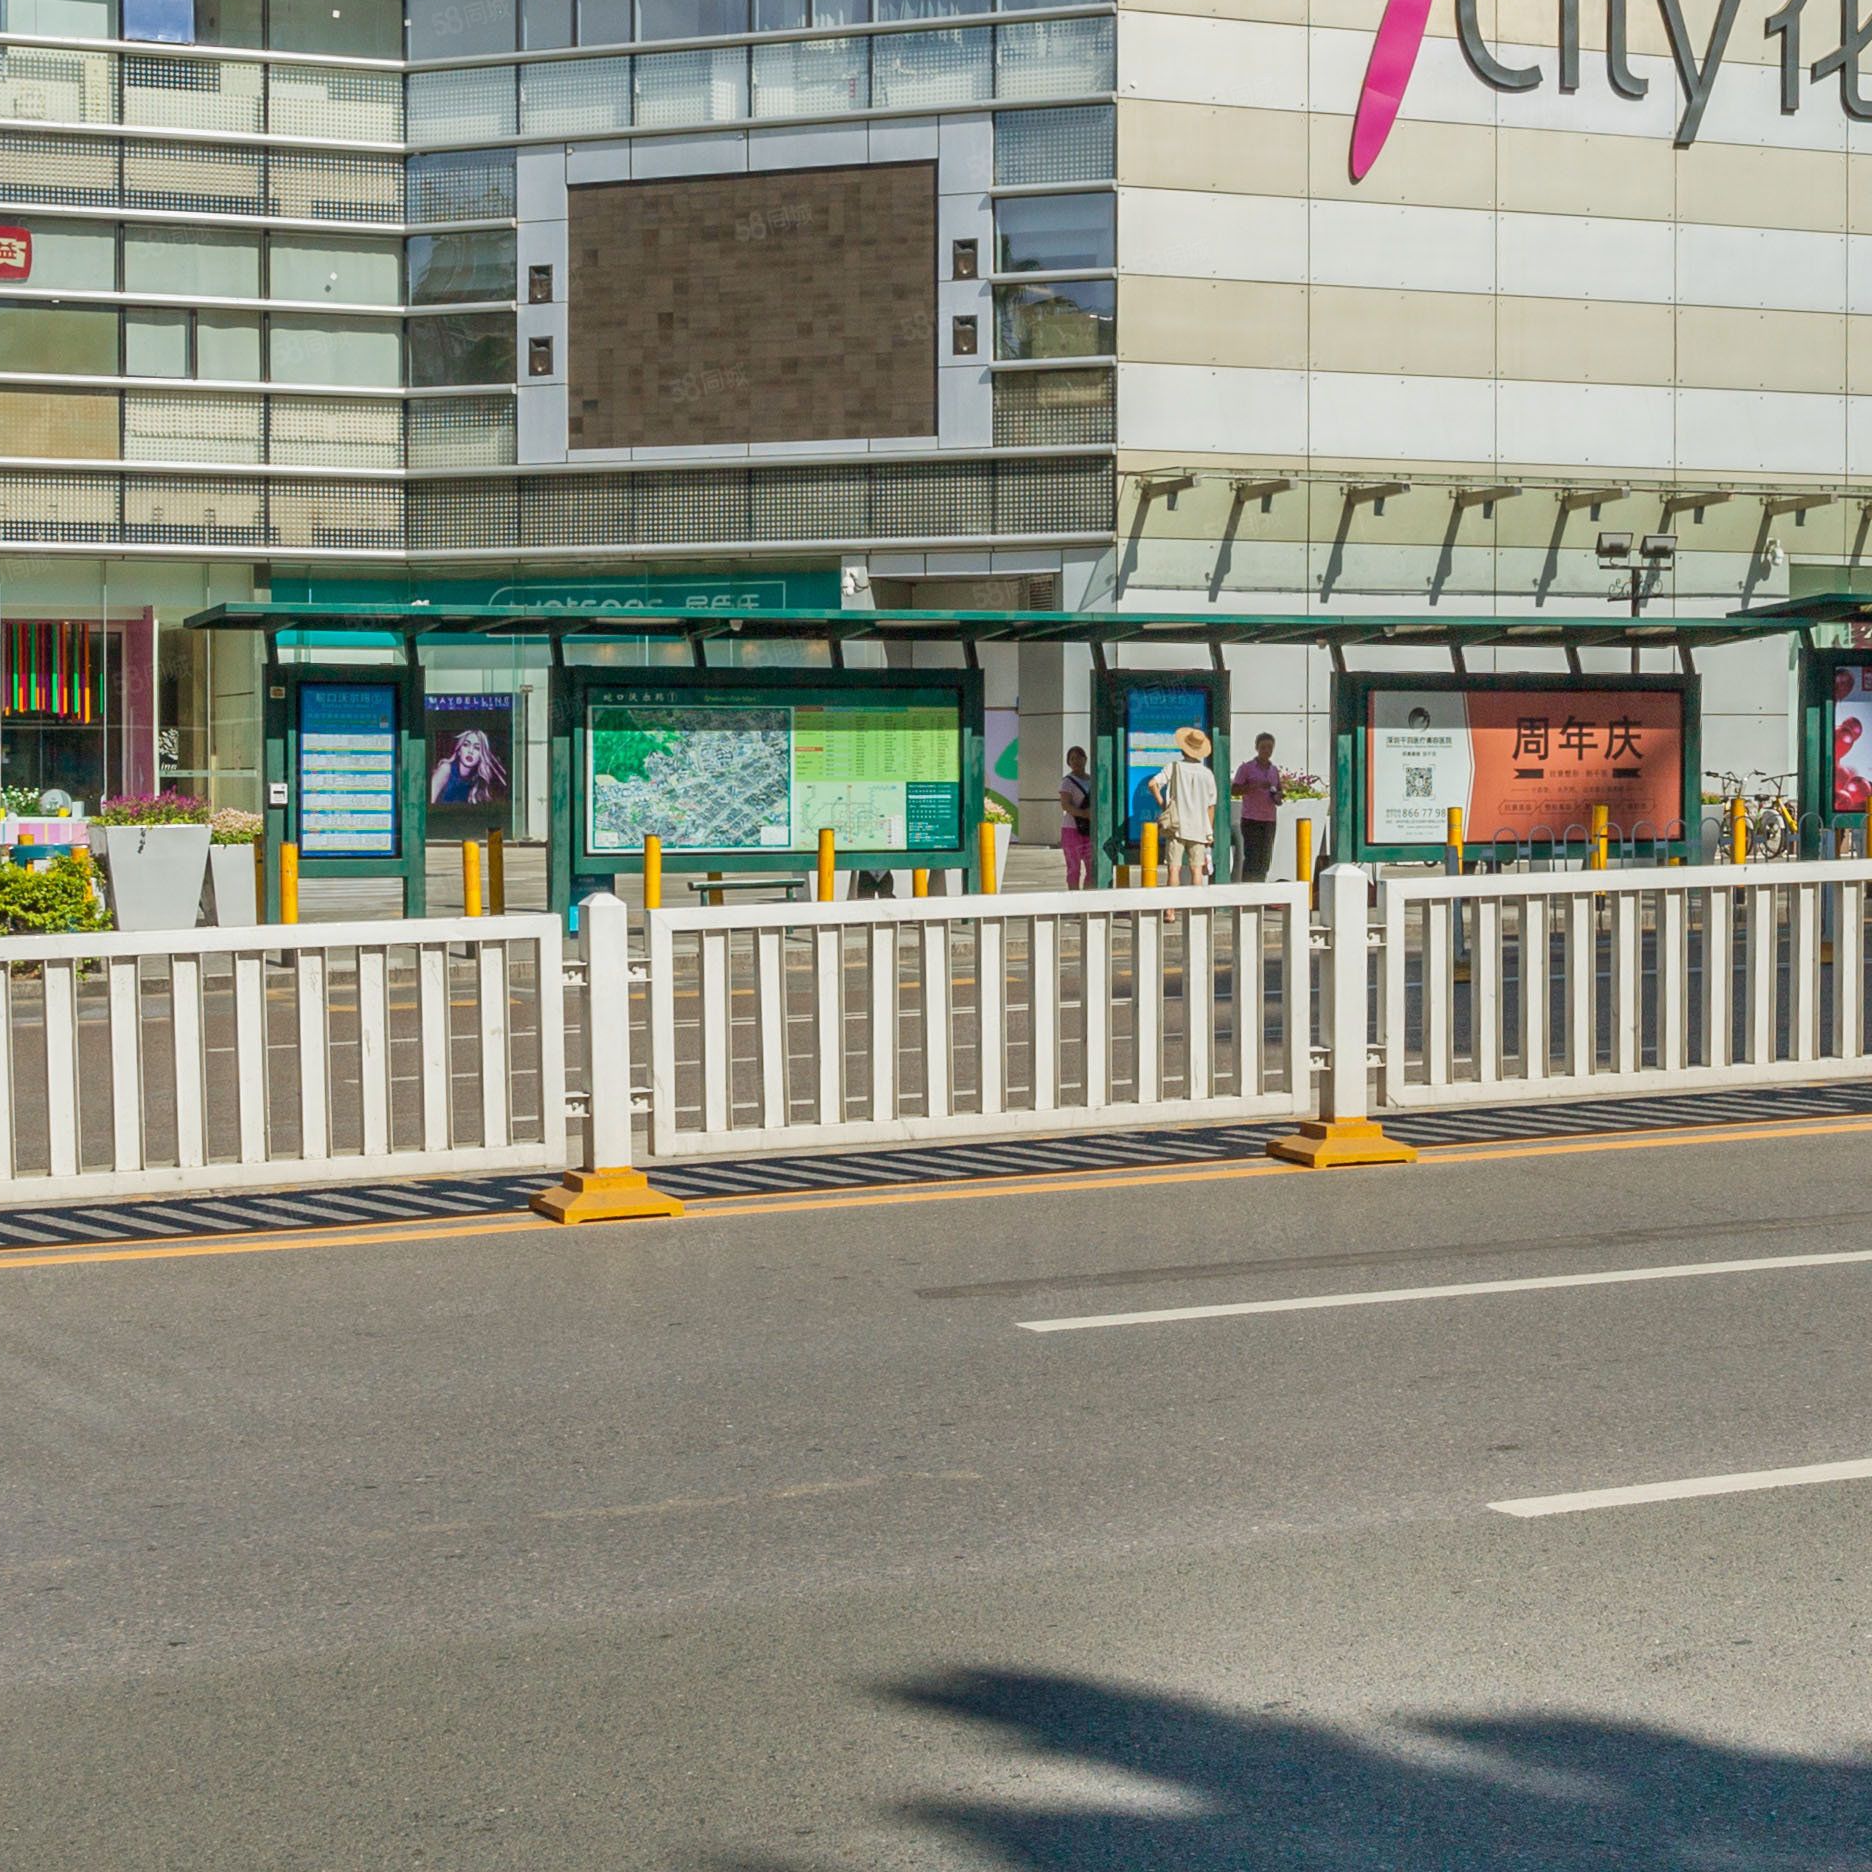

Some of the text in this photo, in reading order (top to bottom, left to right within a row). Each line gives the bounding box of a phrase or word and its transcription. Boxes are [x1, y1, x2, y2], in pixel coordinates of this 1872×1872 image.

[428, 695, 511, 706] MAYBELLINE
[1512, 715, 1644, 761] 周年庆
